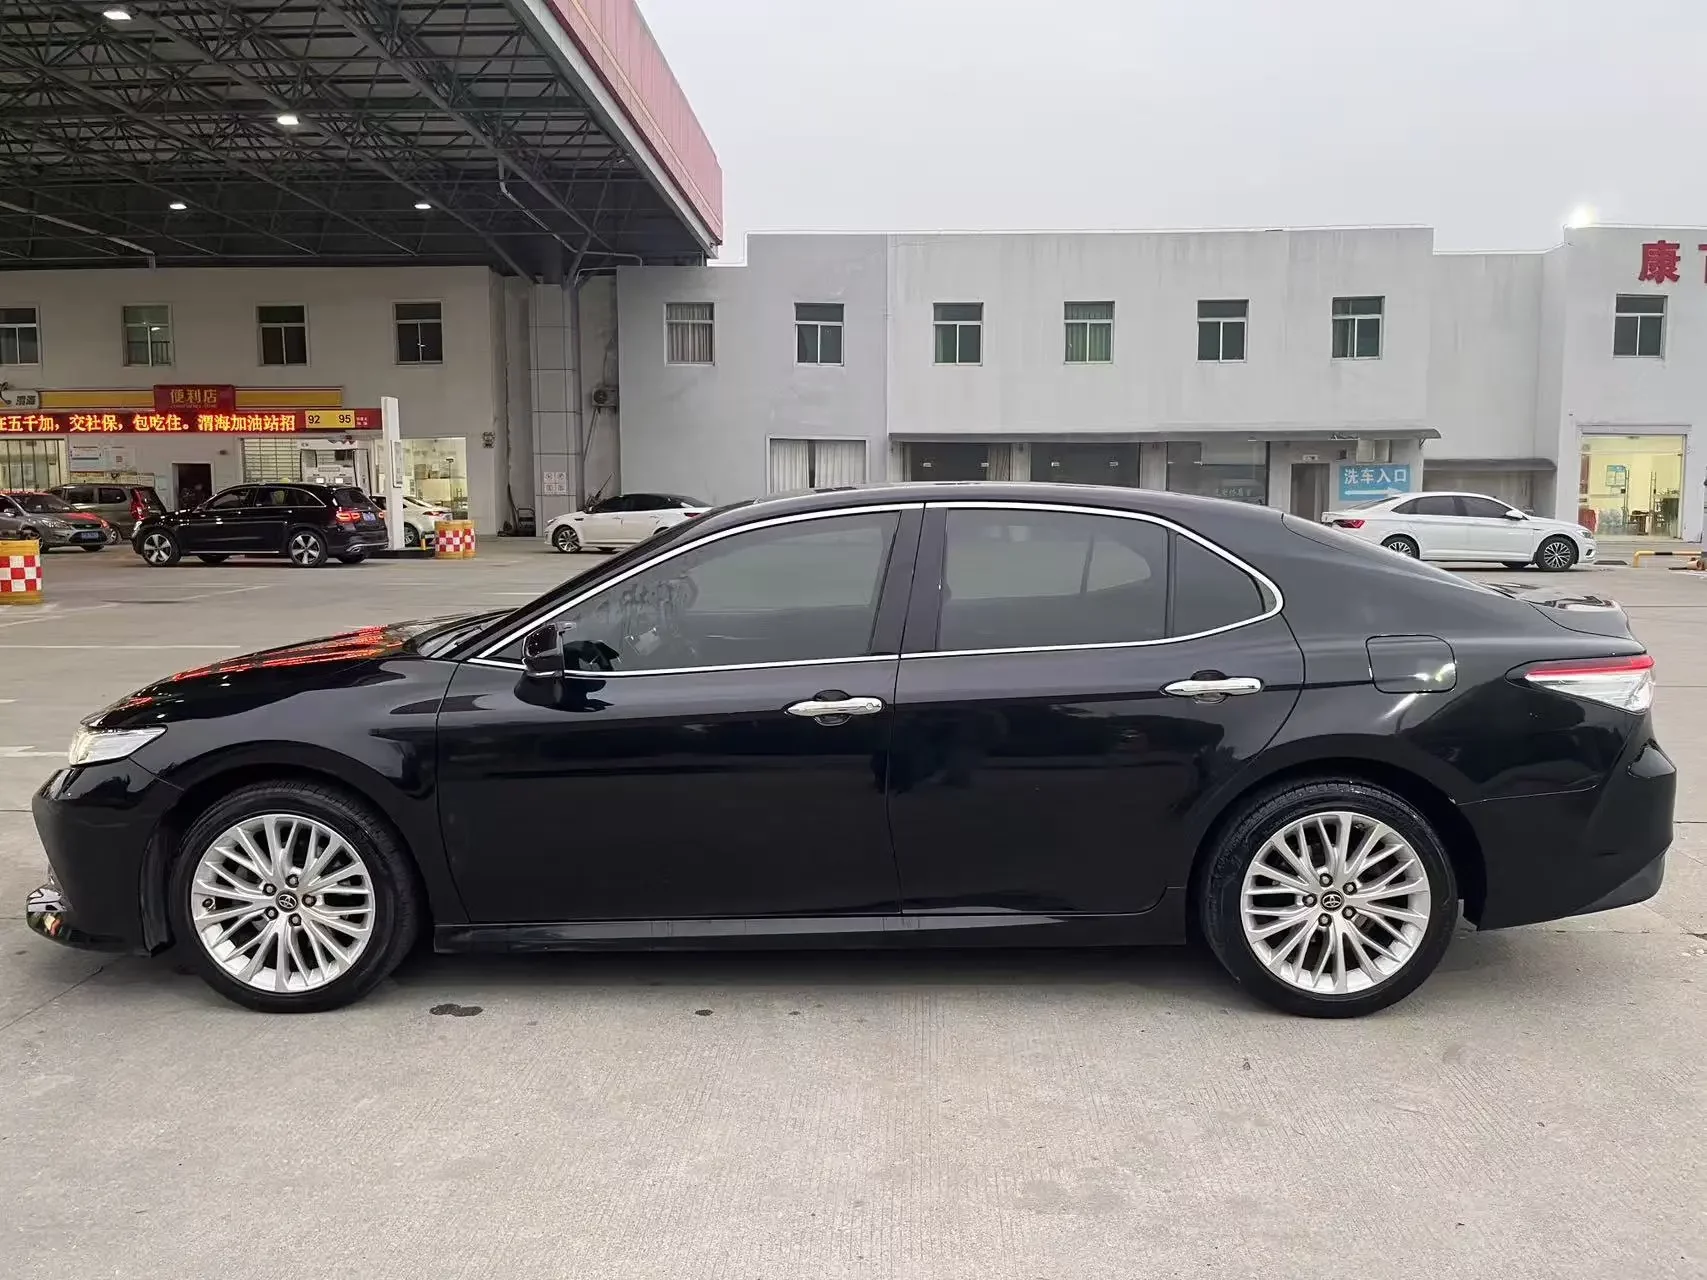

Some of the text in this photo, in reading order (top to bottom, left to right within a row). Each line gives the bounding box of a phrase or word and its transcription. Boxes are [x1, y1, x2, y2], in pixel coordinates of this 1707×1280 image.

[170, 388, 217, 404] 便利店
[307, 414, 321, 424] 92
[338, 414, 351, 424] 95
[1343, 467, 1408, 485] 洗车入口
